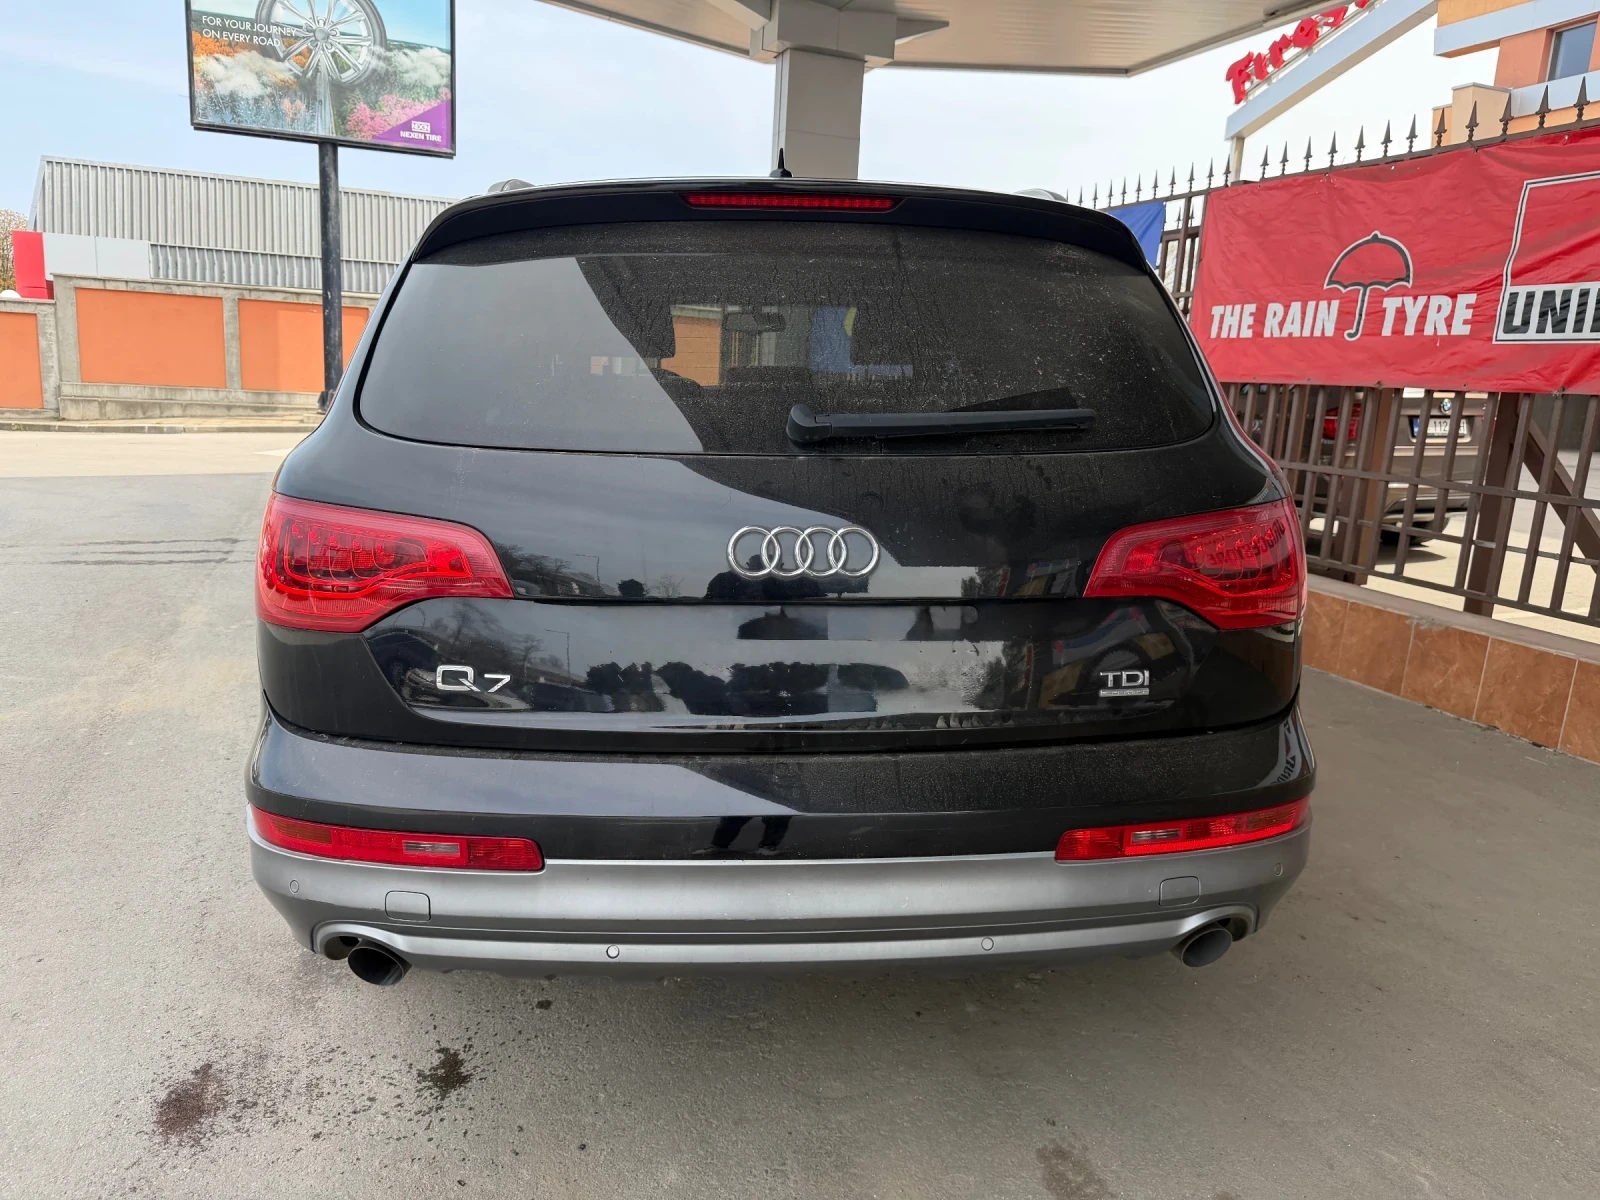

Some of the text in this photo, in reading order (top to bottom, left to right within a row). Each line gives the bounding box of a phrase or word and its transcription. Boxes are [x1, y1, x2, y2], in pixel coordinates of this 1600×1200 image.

[202, 15, 297, 37] FOR YOUR JOURNEY
[202, 28, 281, 47] ON EVERY ROAD
[400, 130, 442, 142] NEXEN TIRE
[1210, 300, 1340, 339] THE RAIN
[1381, 293, 1477, 337] TYRE
[1099, 669, 1150, 688] TDI
